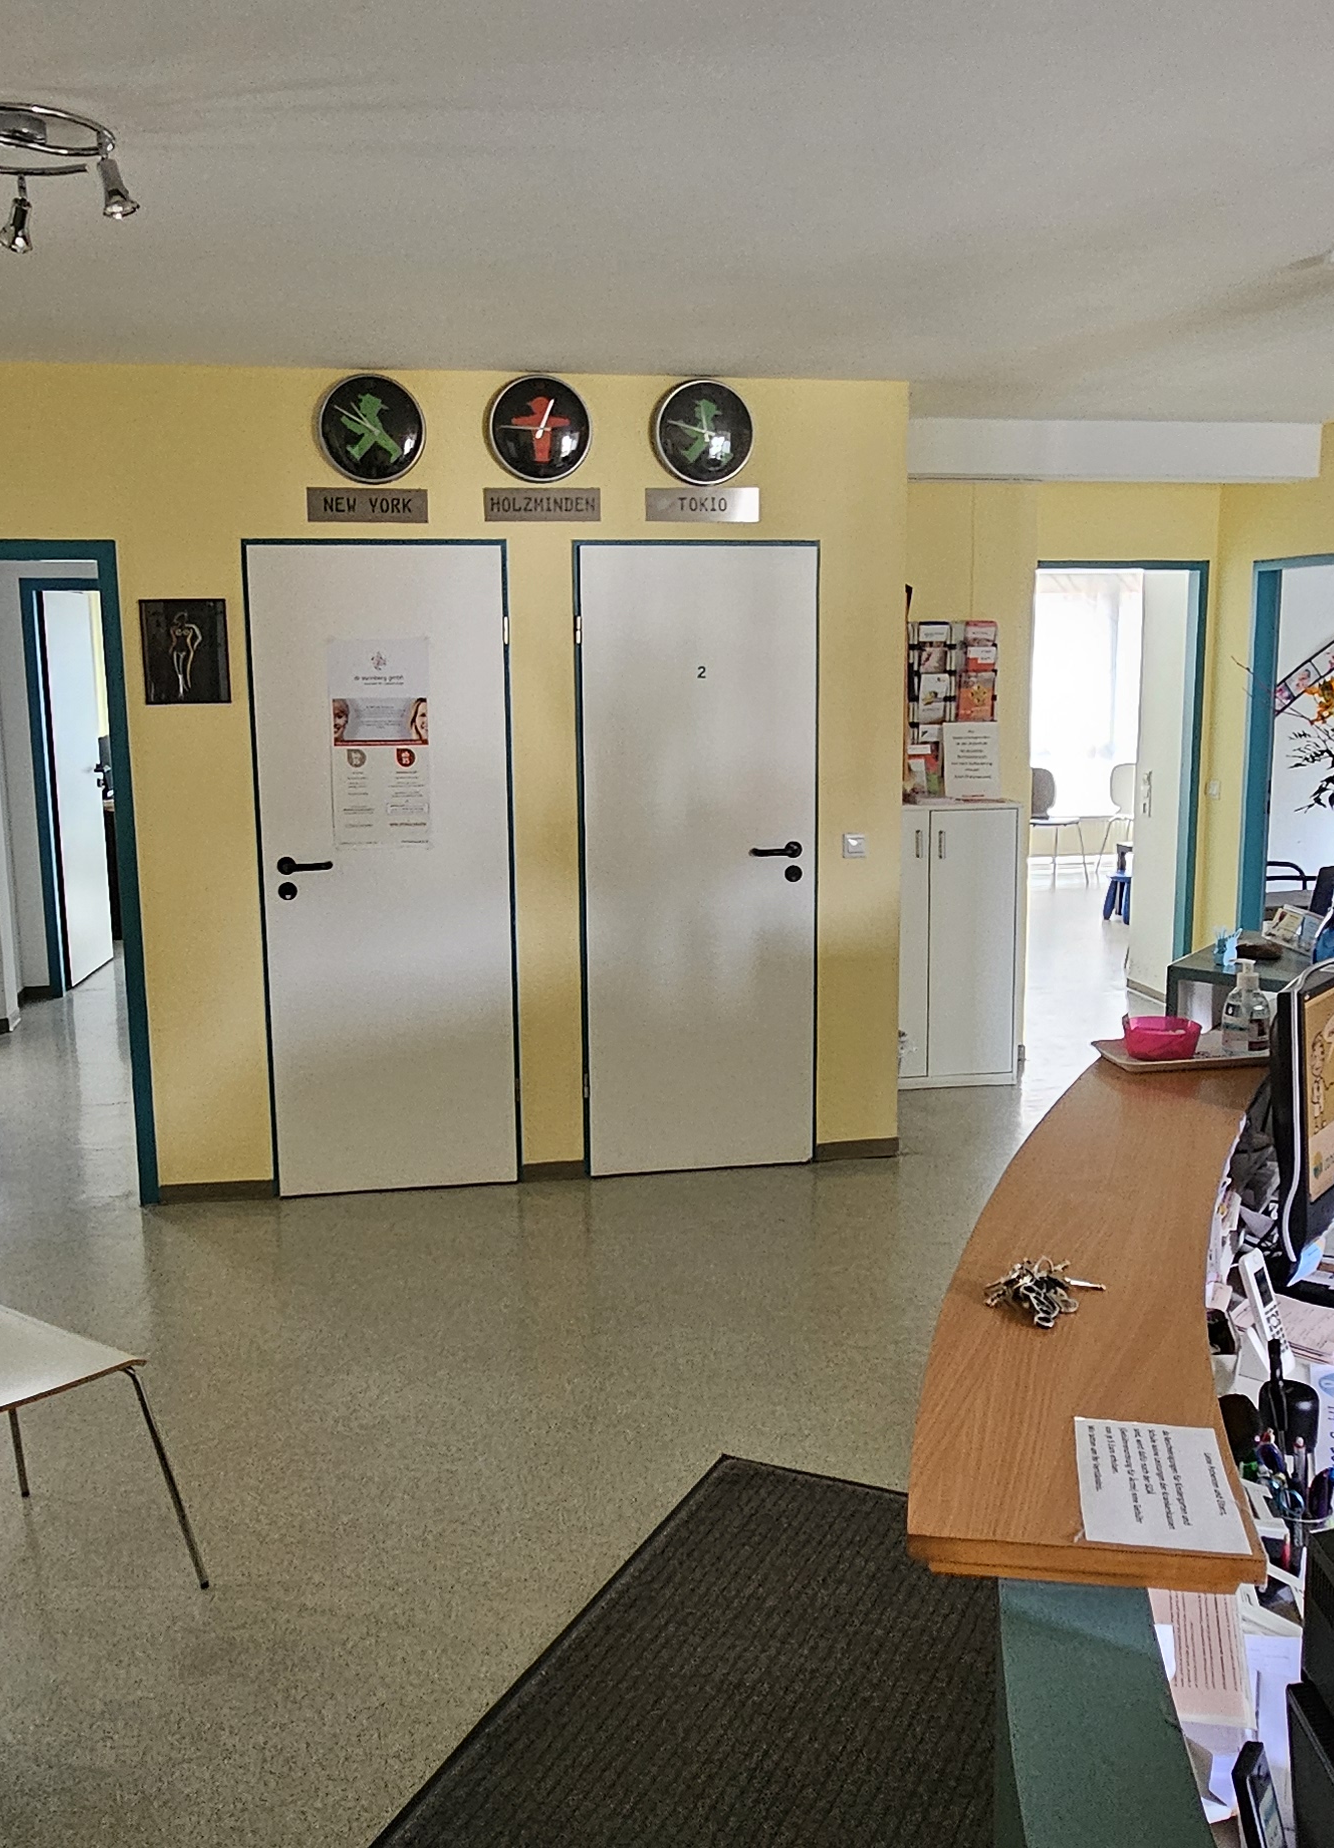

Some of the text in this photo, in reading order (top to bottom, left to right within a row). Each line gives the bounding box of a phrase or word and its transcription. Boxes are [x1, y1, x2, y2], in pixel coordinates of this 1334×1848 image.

[322, 496, 413, 514] NEW YORK
[489, 496, 597, 513] HOLZMINDEN
[677, 496, 728, 513] TOKIO
[696, 665, 708, 680] 2
[1214, 1489, 1223, 1499] und
[1175, 1483, 1187, 1514] Kindergarten
[1182, 1515, 1193, 1526] und
